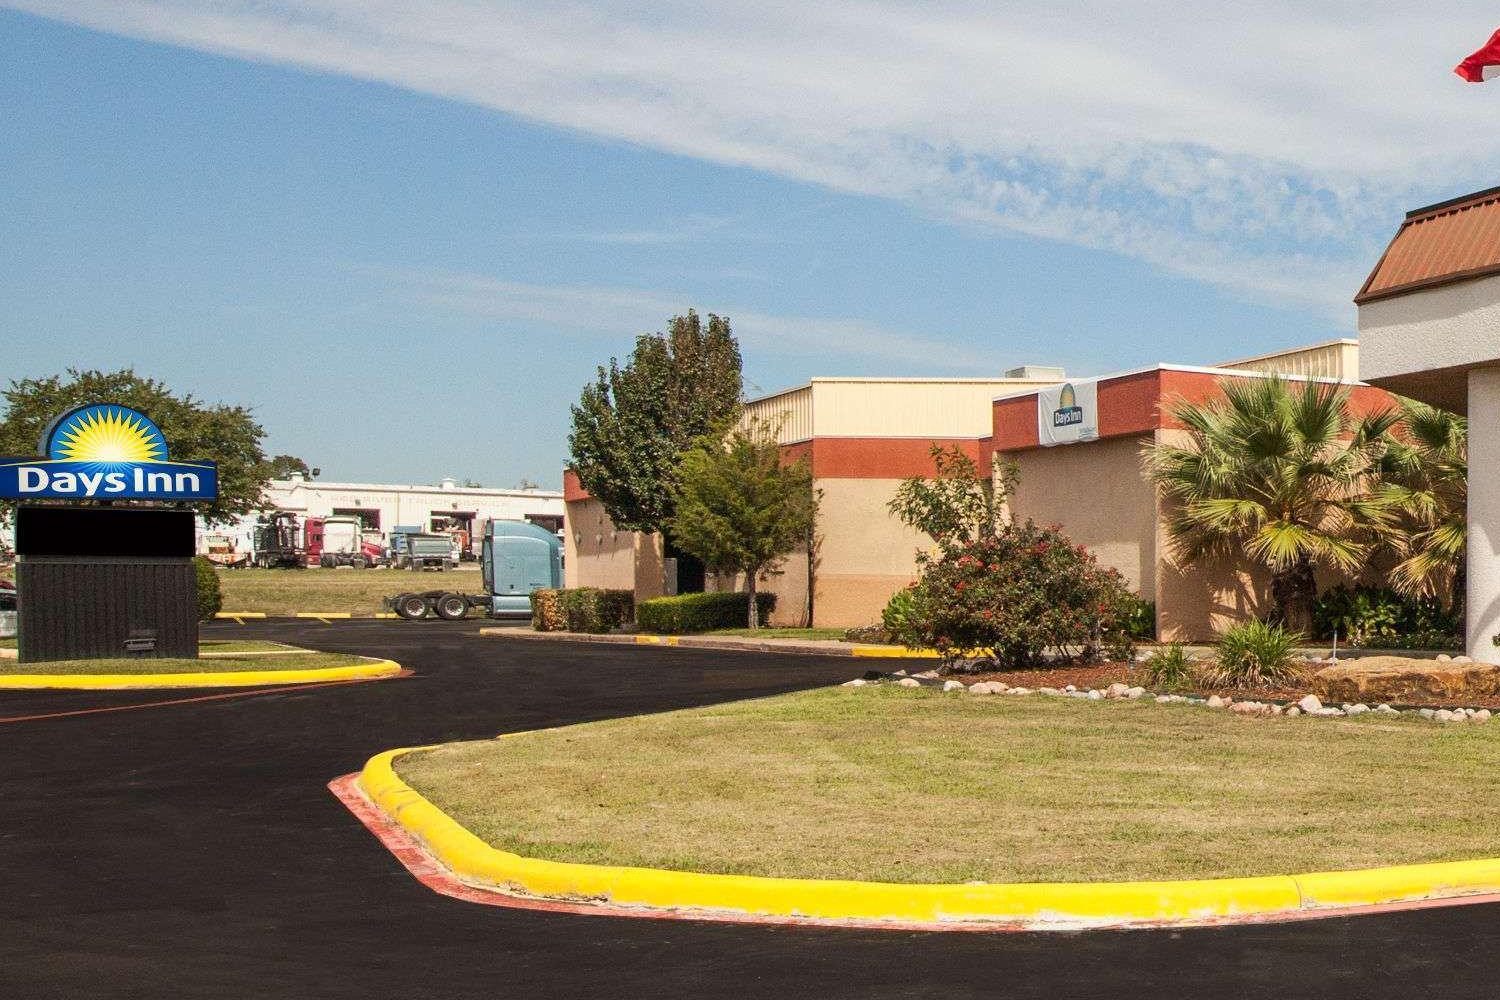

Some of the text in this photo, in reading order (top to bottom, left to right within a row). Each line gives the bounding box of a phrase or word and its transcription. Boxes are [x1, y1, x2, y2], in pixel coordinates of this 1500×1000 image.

[1055, 410, 1081, 425] Days Inn
[18, 467, 200, 496] Days Inn
